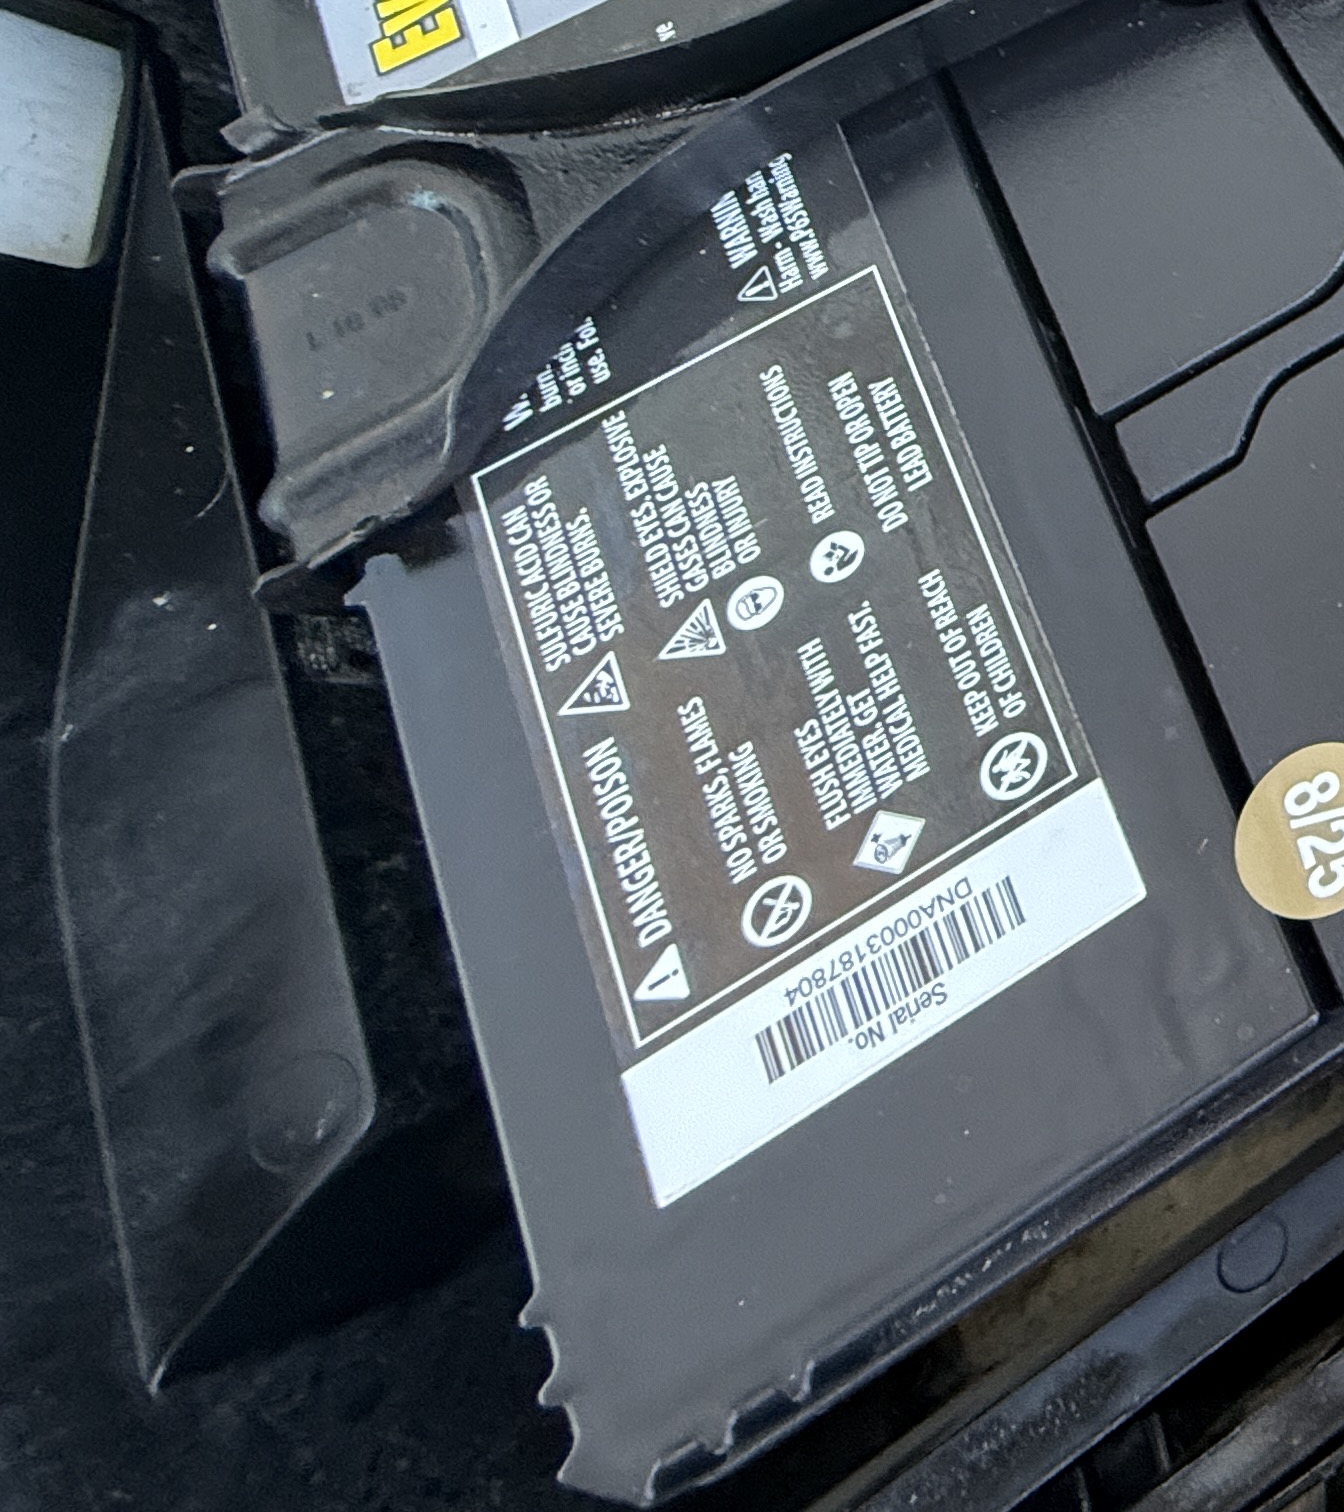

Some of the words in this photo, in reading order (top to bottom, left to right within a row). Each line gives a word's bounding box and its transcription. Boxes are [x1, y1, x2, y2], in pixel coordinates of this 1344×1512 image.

[744, 169, 770, 205] han
[709, 189, 758, 270] WARNIN
[750, 197, 784, 244] Wash
[768, 152, 829, 281] www.P65Warning
[773, 246, 803, 294] Harm
[574, 316, 600, 350] Fol
[537, 364, 563, 413] burn
[566, 376, 587, 396] or
[588, 347, 611, 385] use.
[759, 364, 818, 480] INSTRUCTIONS
[827, 371, 865, 420] OPEN
[867, 376, 917, 450] BATTERY
[844, 413, 874, 444] OR
[601, 410, 649, 501] EXPLOSIVE
[642, 443, 679, 501] CAUSE
[853, 442, 884, 473] TIP
[896, 444, 933, 492] LEAD
[524, 475, 552, 506] OR
[711, 475, 753, 539] INJURY
[800, 475, 835, 524] READ
[863, 466, 898, 507] NOT
[501, 504, 533, 545] CAN
[565, 507, 605, 578] BURNS.
[629, 494, 664, 547] EYES.
[659, 497, 691, 538] CAN
[684, 481, 736, 580] BLINDNESS
[877, 500, 908, 533] DO
[513, 543, 546, 586] ACID
[531, 502, 581, 601] BLINDNESS
[671, 534, 709, 592] GASES
[733, 532, 761, 564] OR
[644, 542, 684, 608] SHIELD
[917, 568, 958, 630] REACH
[523, 581, 571, 672] SULFURIC
[559, 594, 597, 656] CAUSE
[583, 571, 624, 642] SEVERE
[847, 600, 883, 654] FAST.
[797, 637, 834, 694] WITH
[939, 627, 967, 653] OF
[965, 603, 1016, 693] CHILDREN
[864, 652, 901, 701] HELP
[948, 650, 981, 690] OUT
[845, 687, 878, 726] GET
[963, 690, 999, 737] KEEP
[998, 691, 1026, 718] OF
[677, 696, 722, 775] FLAMES
[793, 718, 830, 770] EYES
[814, 688, 877, 814] IMMEDIATELY
[861, 721, 903, 799] WATER.
[882, 693, 930, 782] MEDICAL
[702, 767, 747, 852] SPARKS,
[728, 740, 778, 835] SMOKING
[809, 763, 851, 830] FLUSH
[582, 736, 672, 948] DANGER/POISON
[726, 847, 757, 884] NO
[757, 827, 787, 864] OR
[781, 874, 974, 1009] DNA0003187804
[887, 977, 951, 1034] Serial
[845, 1019, 886, 1061] No.
